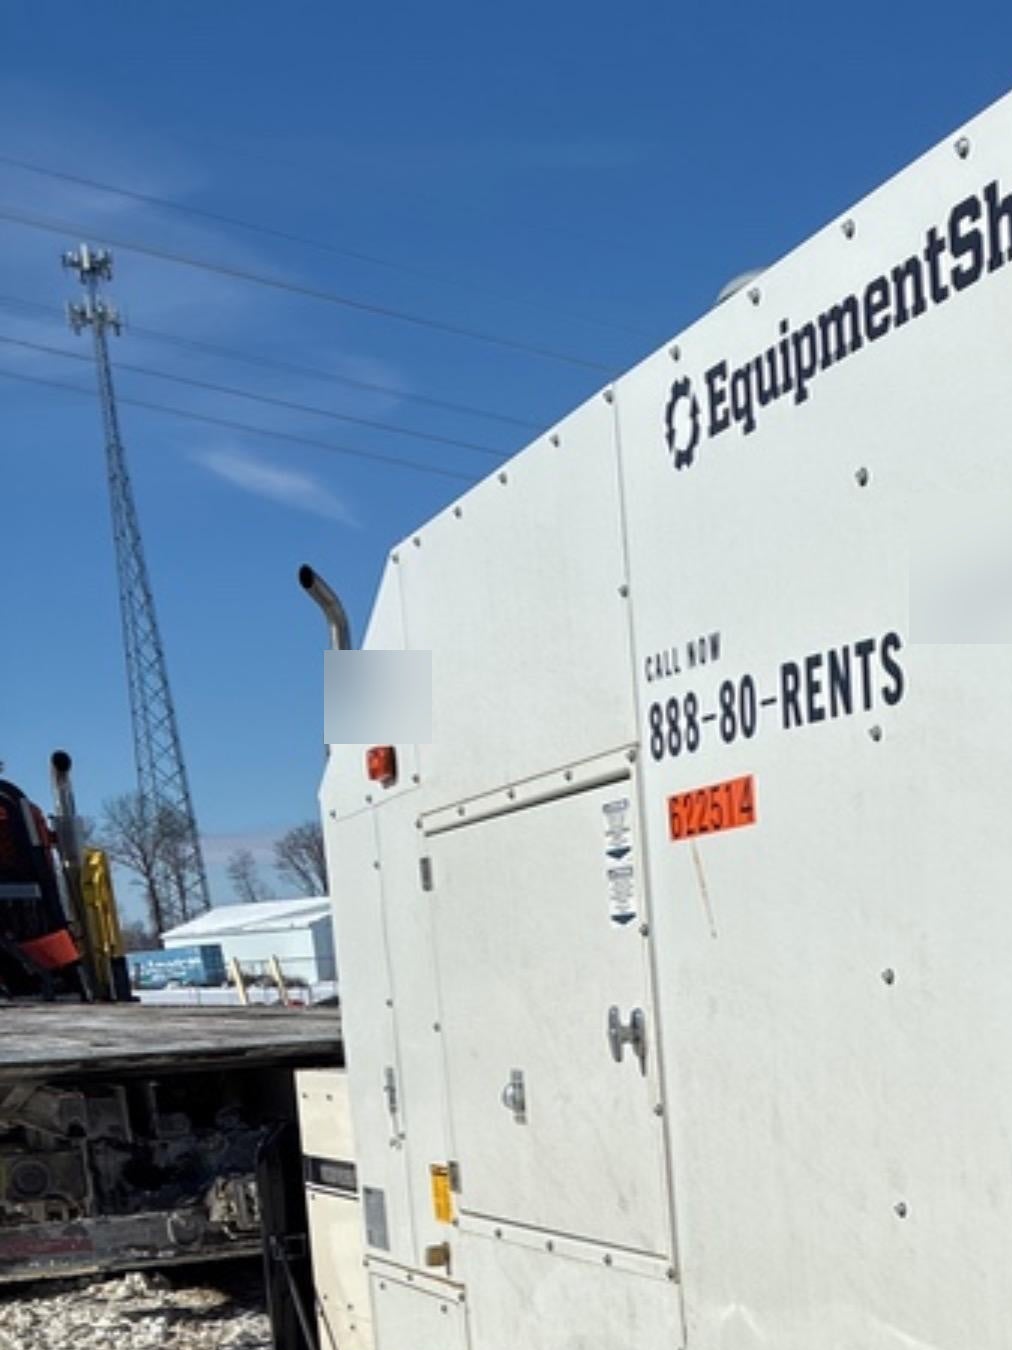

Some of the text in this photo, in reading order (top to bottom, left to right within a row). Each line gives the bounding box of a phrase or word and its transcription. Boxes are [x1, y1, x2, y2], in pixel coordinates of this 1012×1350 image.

[645, 632, 721, 682] CALL NOW
[648, 631, 905, 762] 888-80-RENTS
[669, 775, 753, 839] 622514
